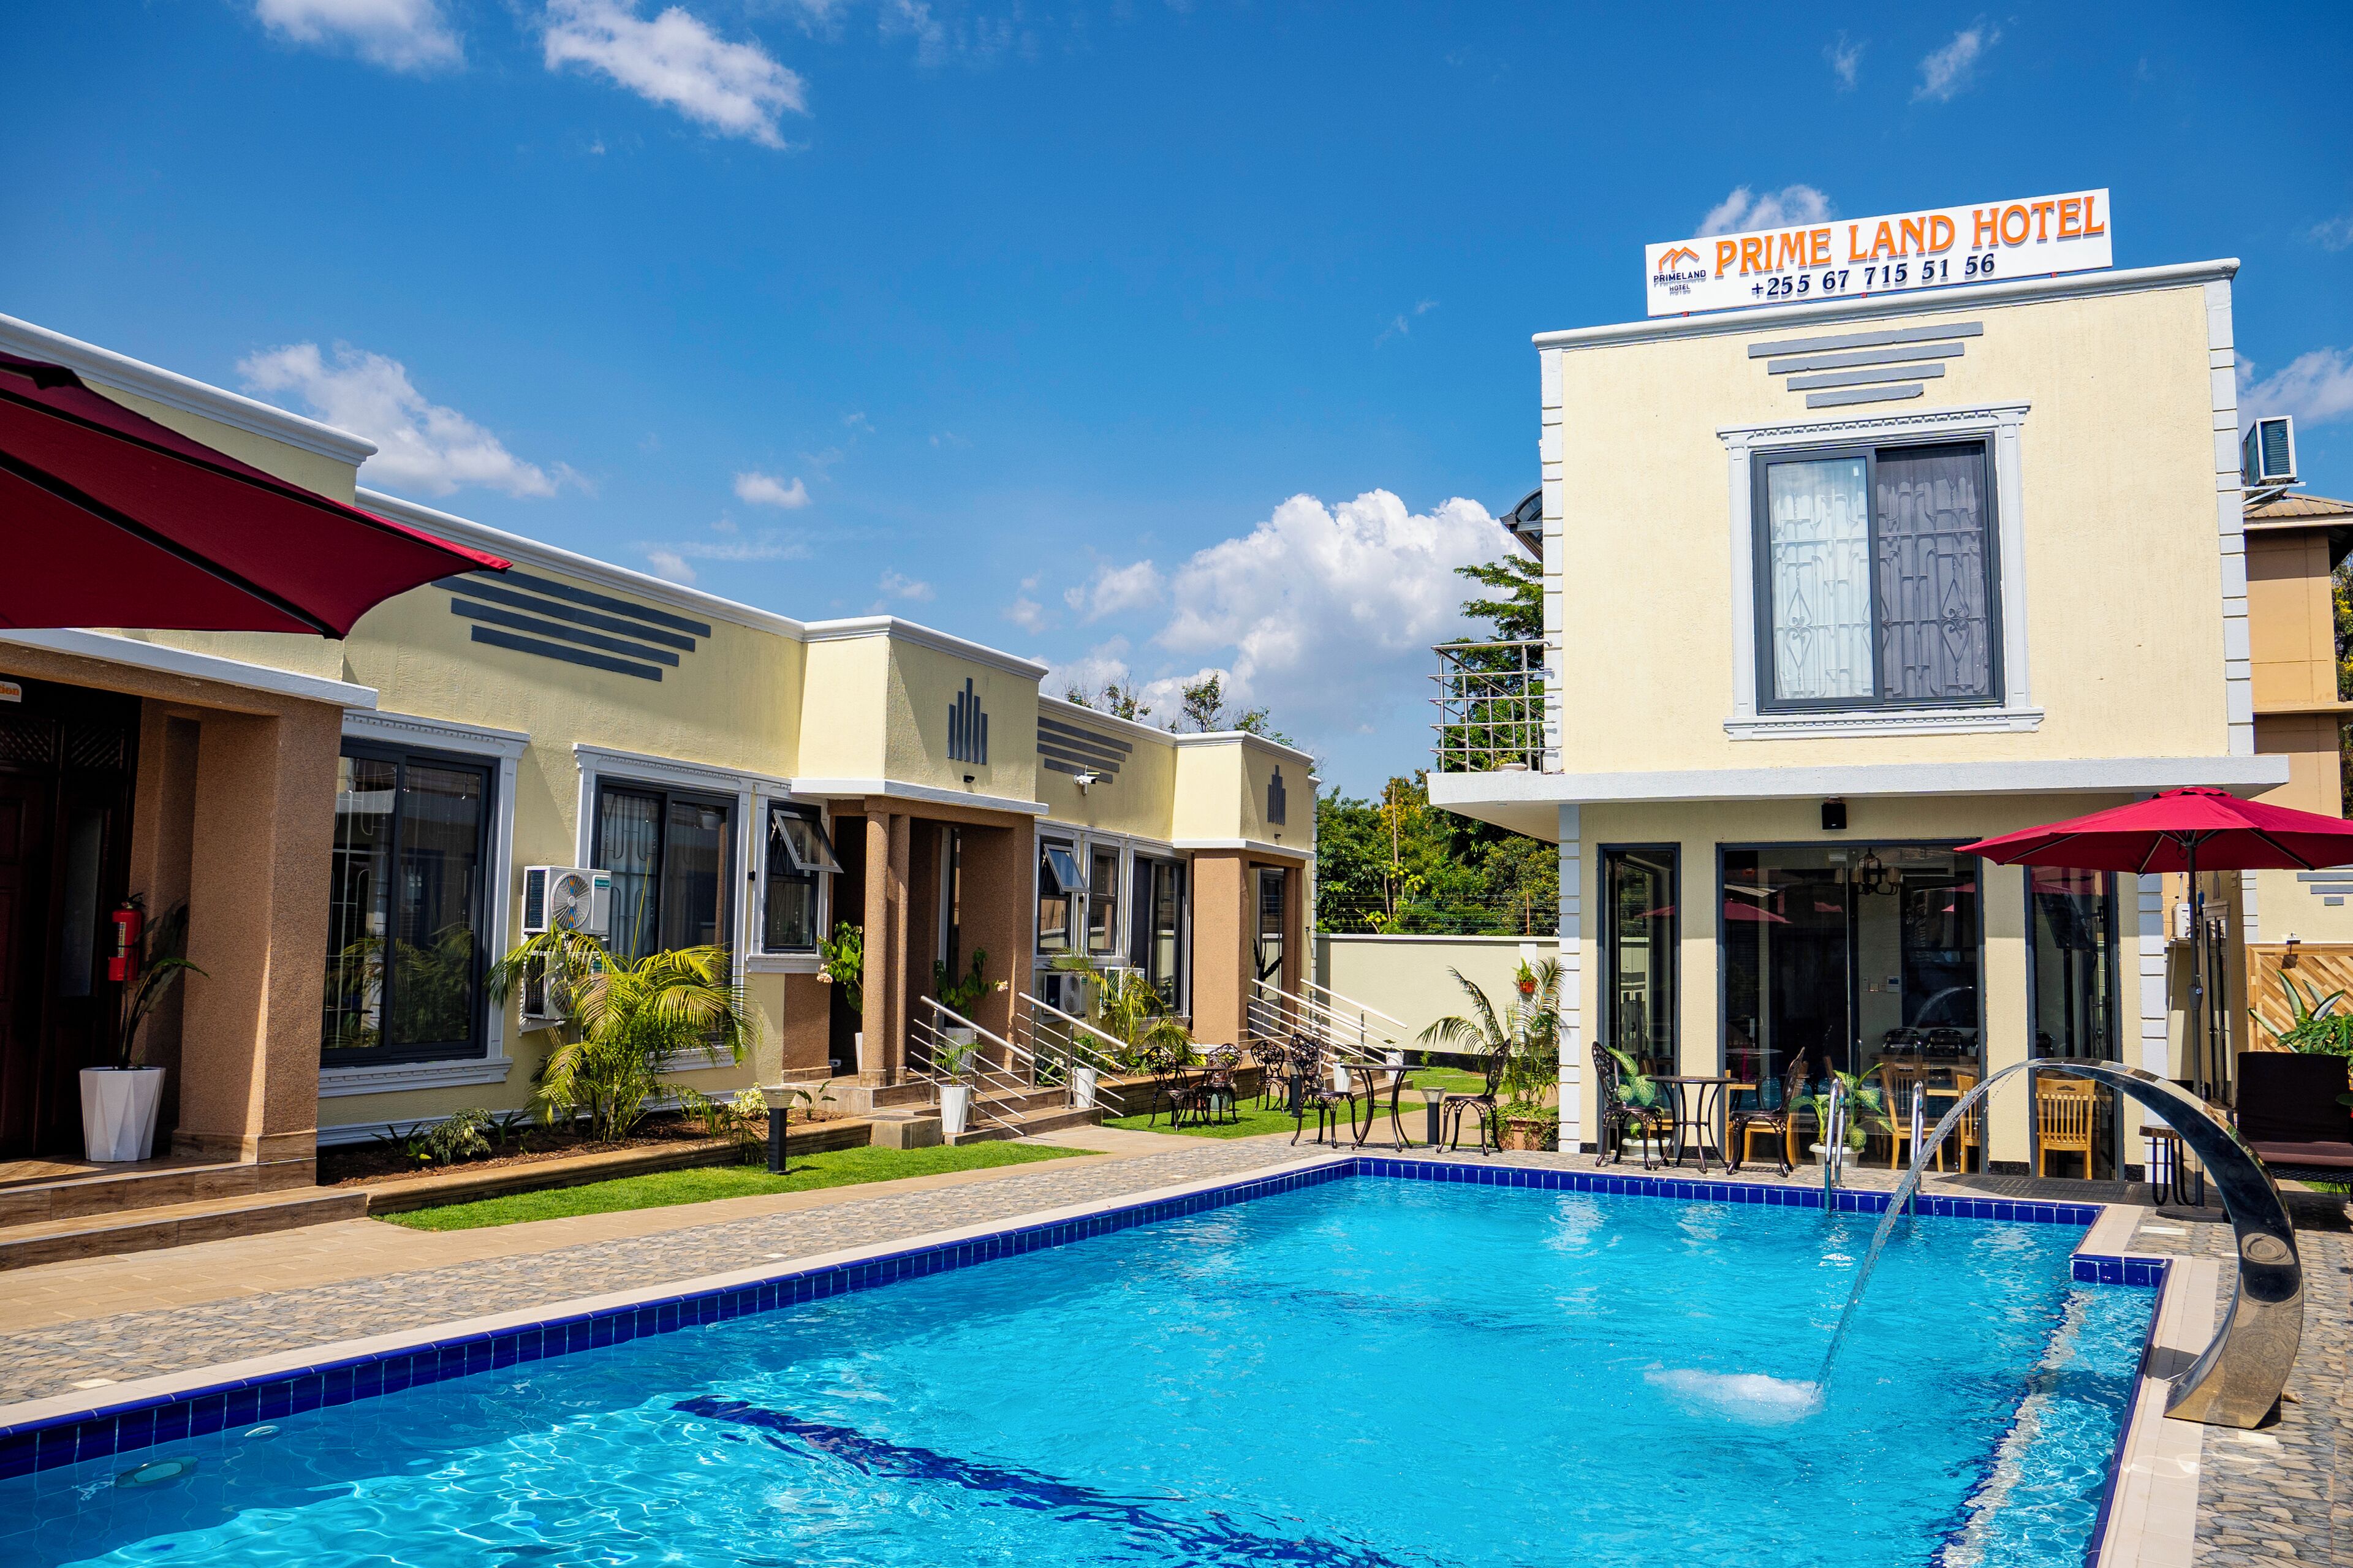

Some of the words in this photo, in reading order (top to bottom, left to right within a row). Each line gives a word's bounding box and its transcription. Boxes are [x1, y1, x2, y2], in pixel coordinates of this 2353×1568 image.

[1715, 229, 1832, 277] PRIME
[1848, 214, 1956, 261] LAND
[1972, 196, 2105, 247] HOTEL
[1653, 270, 1707, 284] PRIMELAND
[1751, 275, 1811, 297] +255
[1822, 270, 1849, 290] 67
[1865, 263, 1908, 286] 715
[1922, 260, 1947, 280] 51
[1965, 253, 1995, 275] 56
